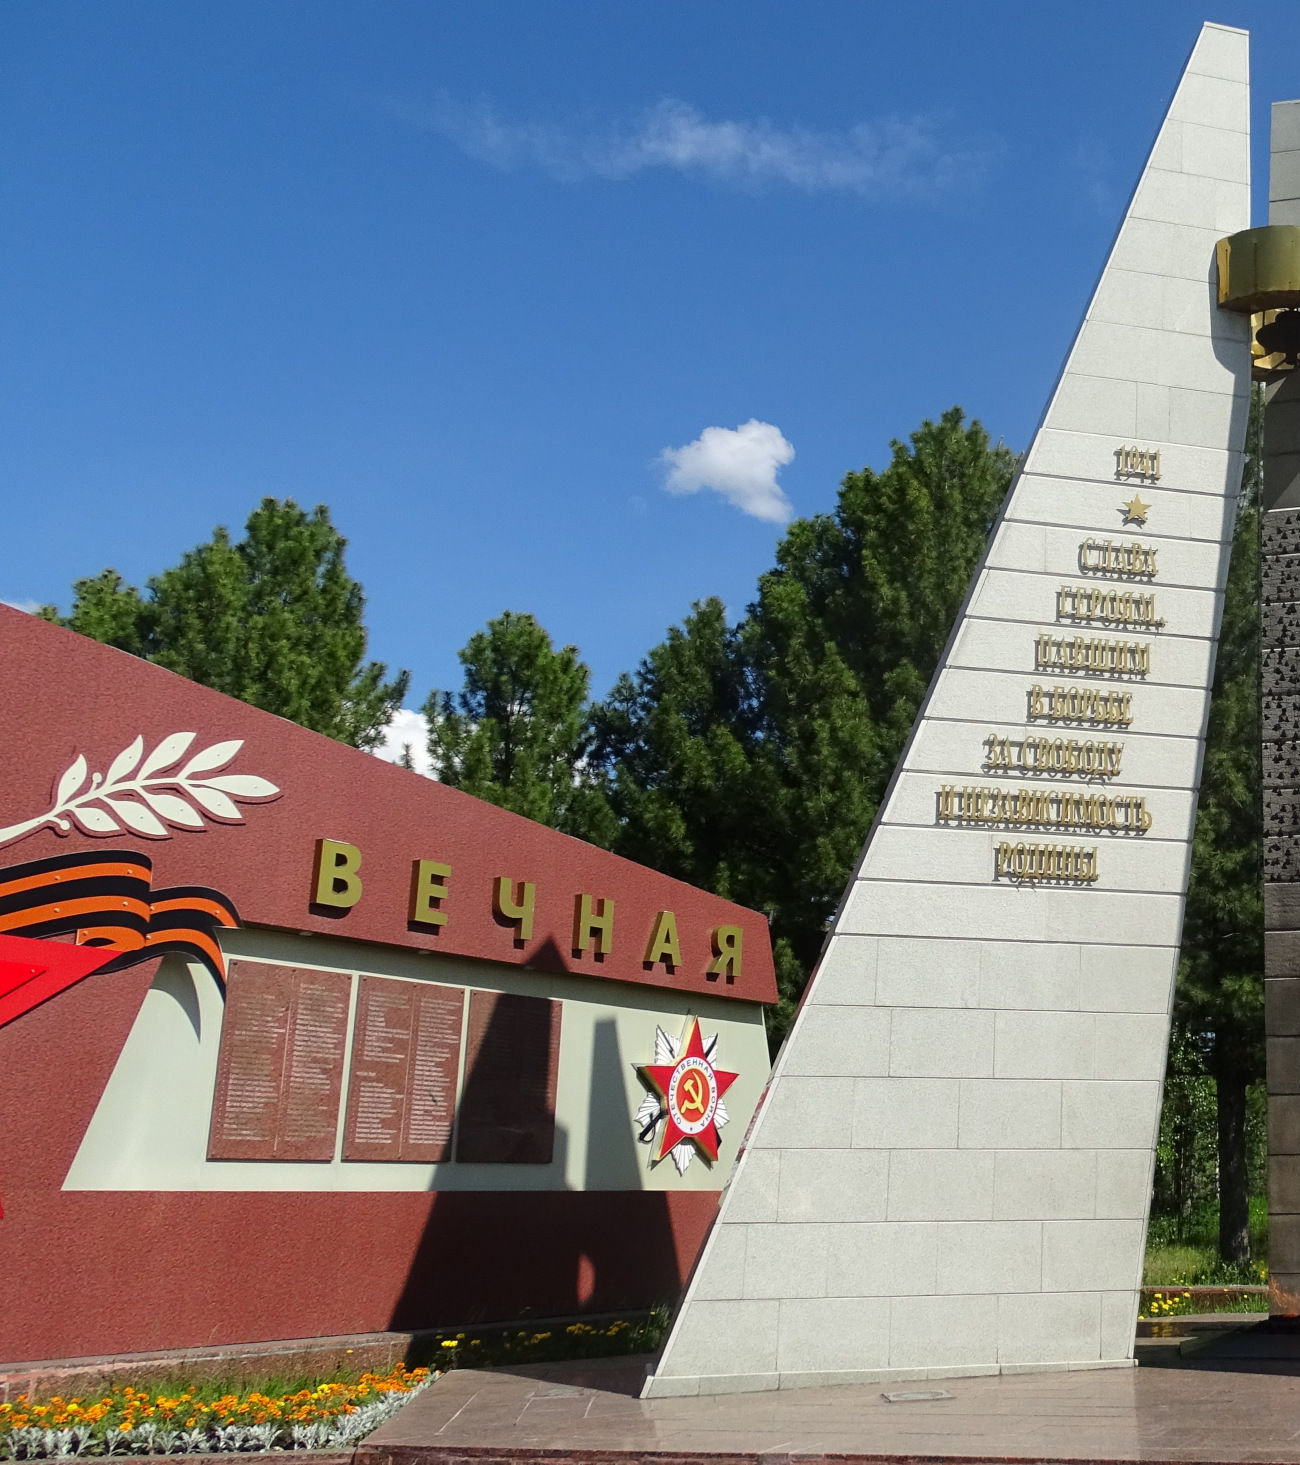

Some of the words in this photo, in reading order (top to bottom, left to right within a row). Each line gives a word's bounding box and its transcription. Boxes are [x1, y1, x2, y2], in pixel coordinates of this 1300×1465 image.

[1118, 444, 1162, 480] 1941
[1082, 537, 1158, 576] СЛАВА
[1038, 634, 1151, 674] ПАВШИМ
[1031, 684, 1044, 717] В
[1052, 686, 1133, 724] БОРЬБЕ
[988, 733, 1014, 768] ЗА
[1021, 735, 1125, 778] СВОБОДУ
[939, 784, 956, 819] И
[961, 785, 1153, 830] НЕЗАВИСИМОСТЬ
[999, 841, 1098, 883] РОДИНЫ
[311, 838, 744, 978] ВЕЧНАЯ
[669, 1059, 715, 1125] ОТЕЧЕСТВЕННАЯ
